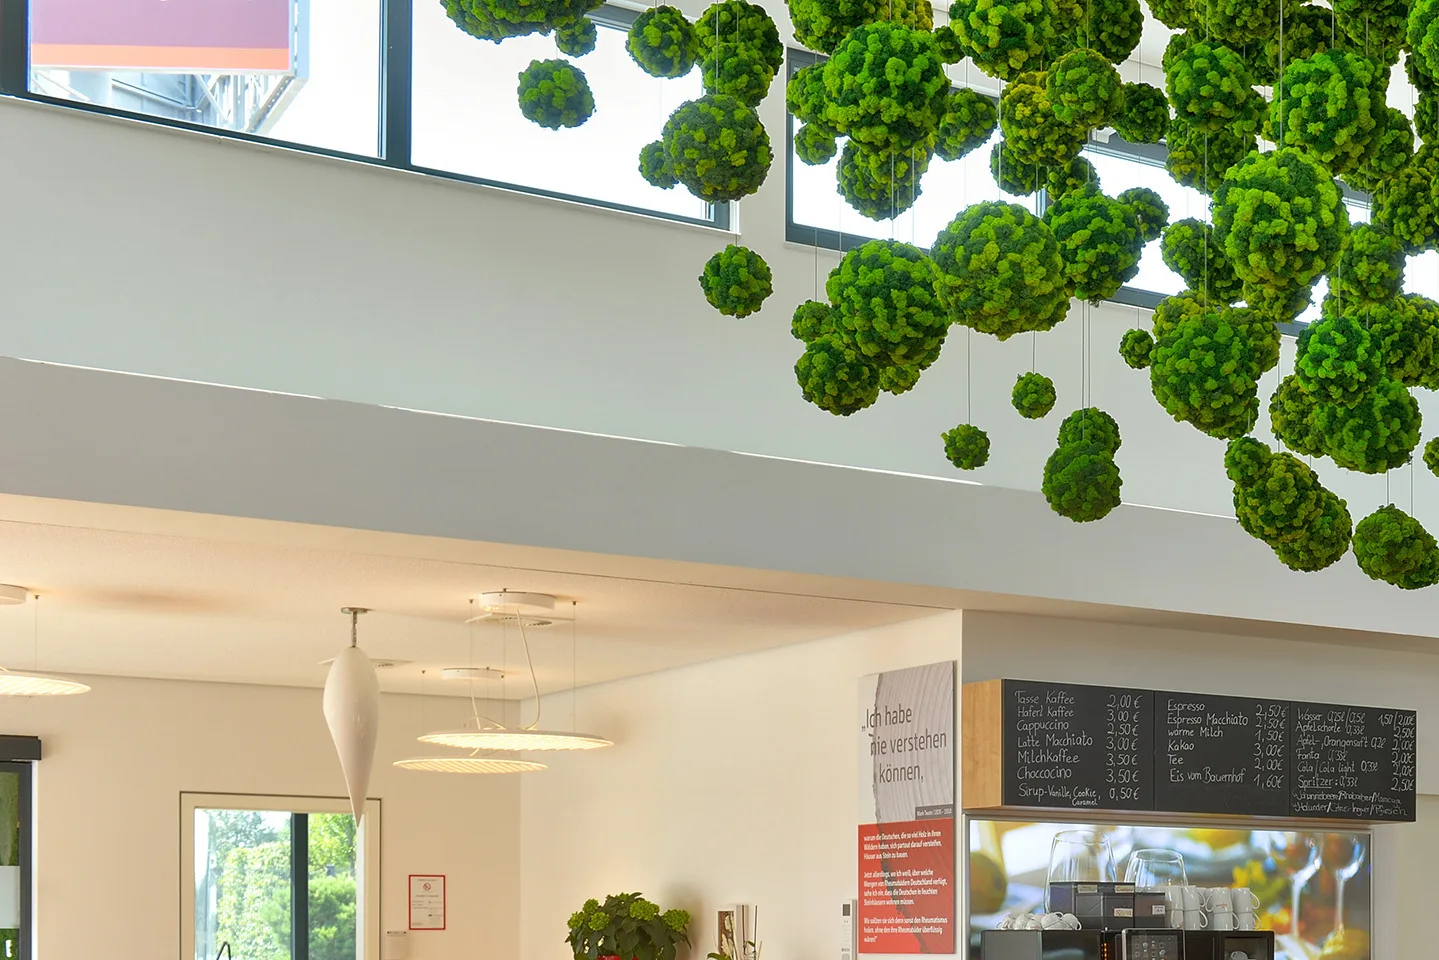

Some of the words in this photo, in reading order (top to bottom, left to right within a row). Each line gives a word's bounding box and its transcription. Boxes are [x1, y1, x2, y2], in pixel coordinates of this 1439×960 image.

[1015, 691, 1039, 704] Tasse
[1045, 691, 1075, 704] Kaffee
[885, 703, 911, 726] habe
[1018, 705, 1043, 717] Haferl
[1047, 706, 1074, 717] Kaffee
[1168, 699, 1205, 717] Espresso
[1297, 708, 1322, 721] Wasser
[1168, 713, 1201, 728] Espresso
[1206, 711, 1248, 726] Macchiato
[1017, 719, 1069, 736] Cappuccino
[1200, 726, 1223, 737] Milch
[1295, 721, 1341, 736] Apfelschorle
[871, 736, 886, 756] nie
[890, 728, 946, 753] verstehen
[1018, 735, 1040, 747] Latte
[1046, 731, 1093, 746] Macchiato
[1168, 739, 1194, 751] Kakao
[1018, 748, 1080, 764] Milchkaffee
[1167, 754, 1184, 764] Tee
[1296, 747, 1319, 760] Fanta
[880, 763, 923, 783] können,
[1017, 766, 1072, 779] Choccocino
[1170, 768, 1184, 782] Eis
[1188, 772, 1201, 780] vom
[1203, 766, 1246, 784] Bauernhof
[1072, 798, 1098, 806] Caramel
